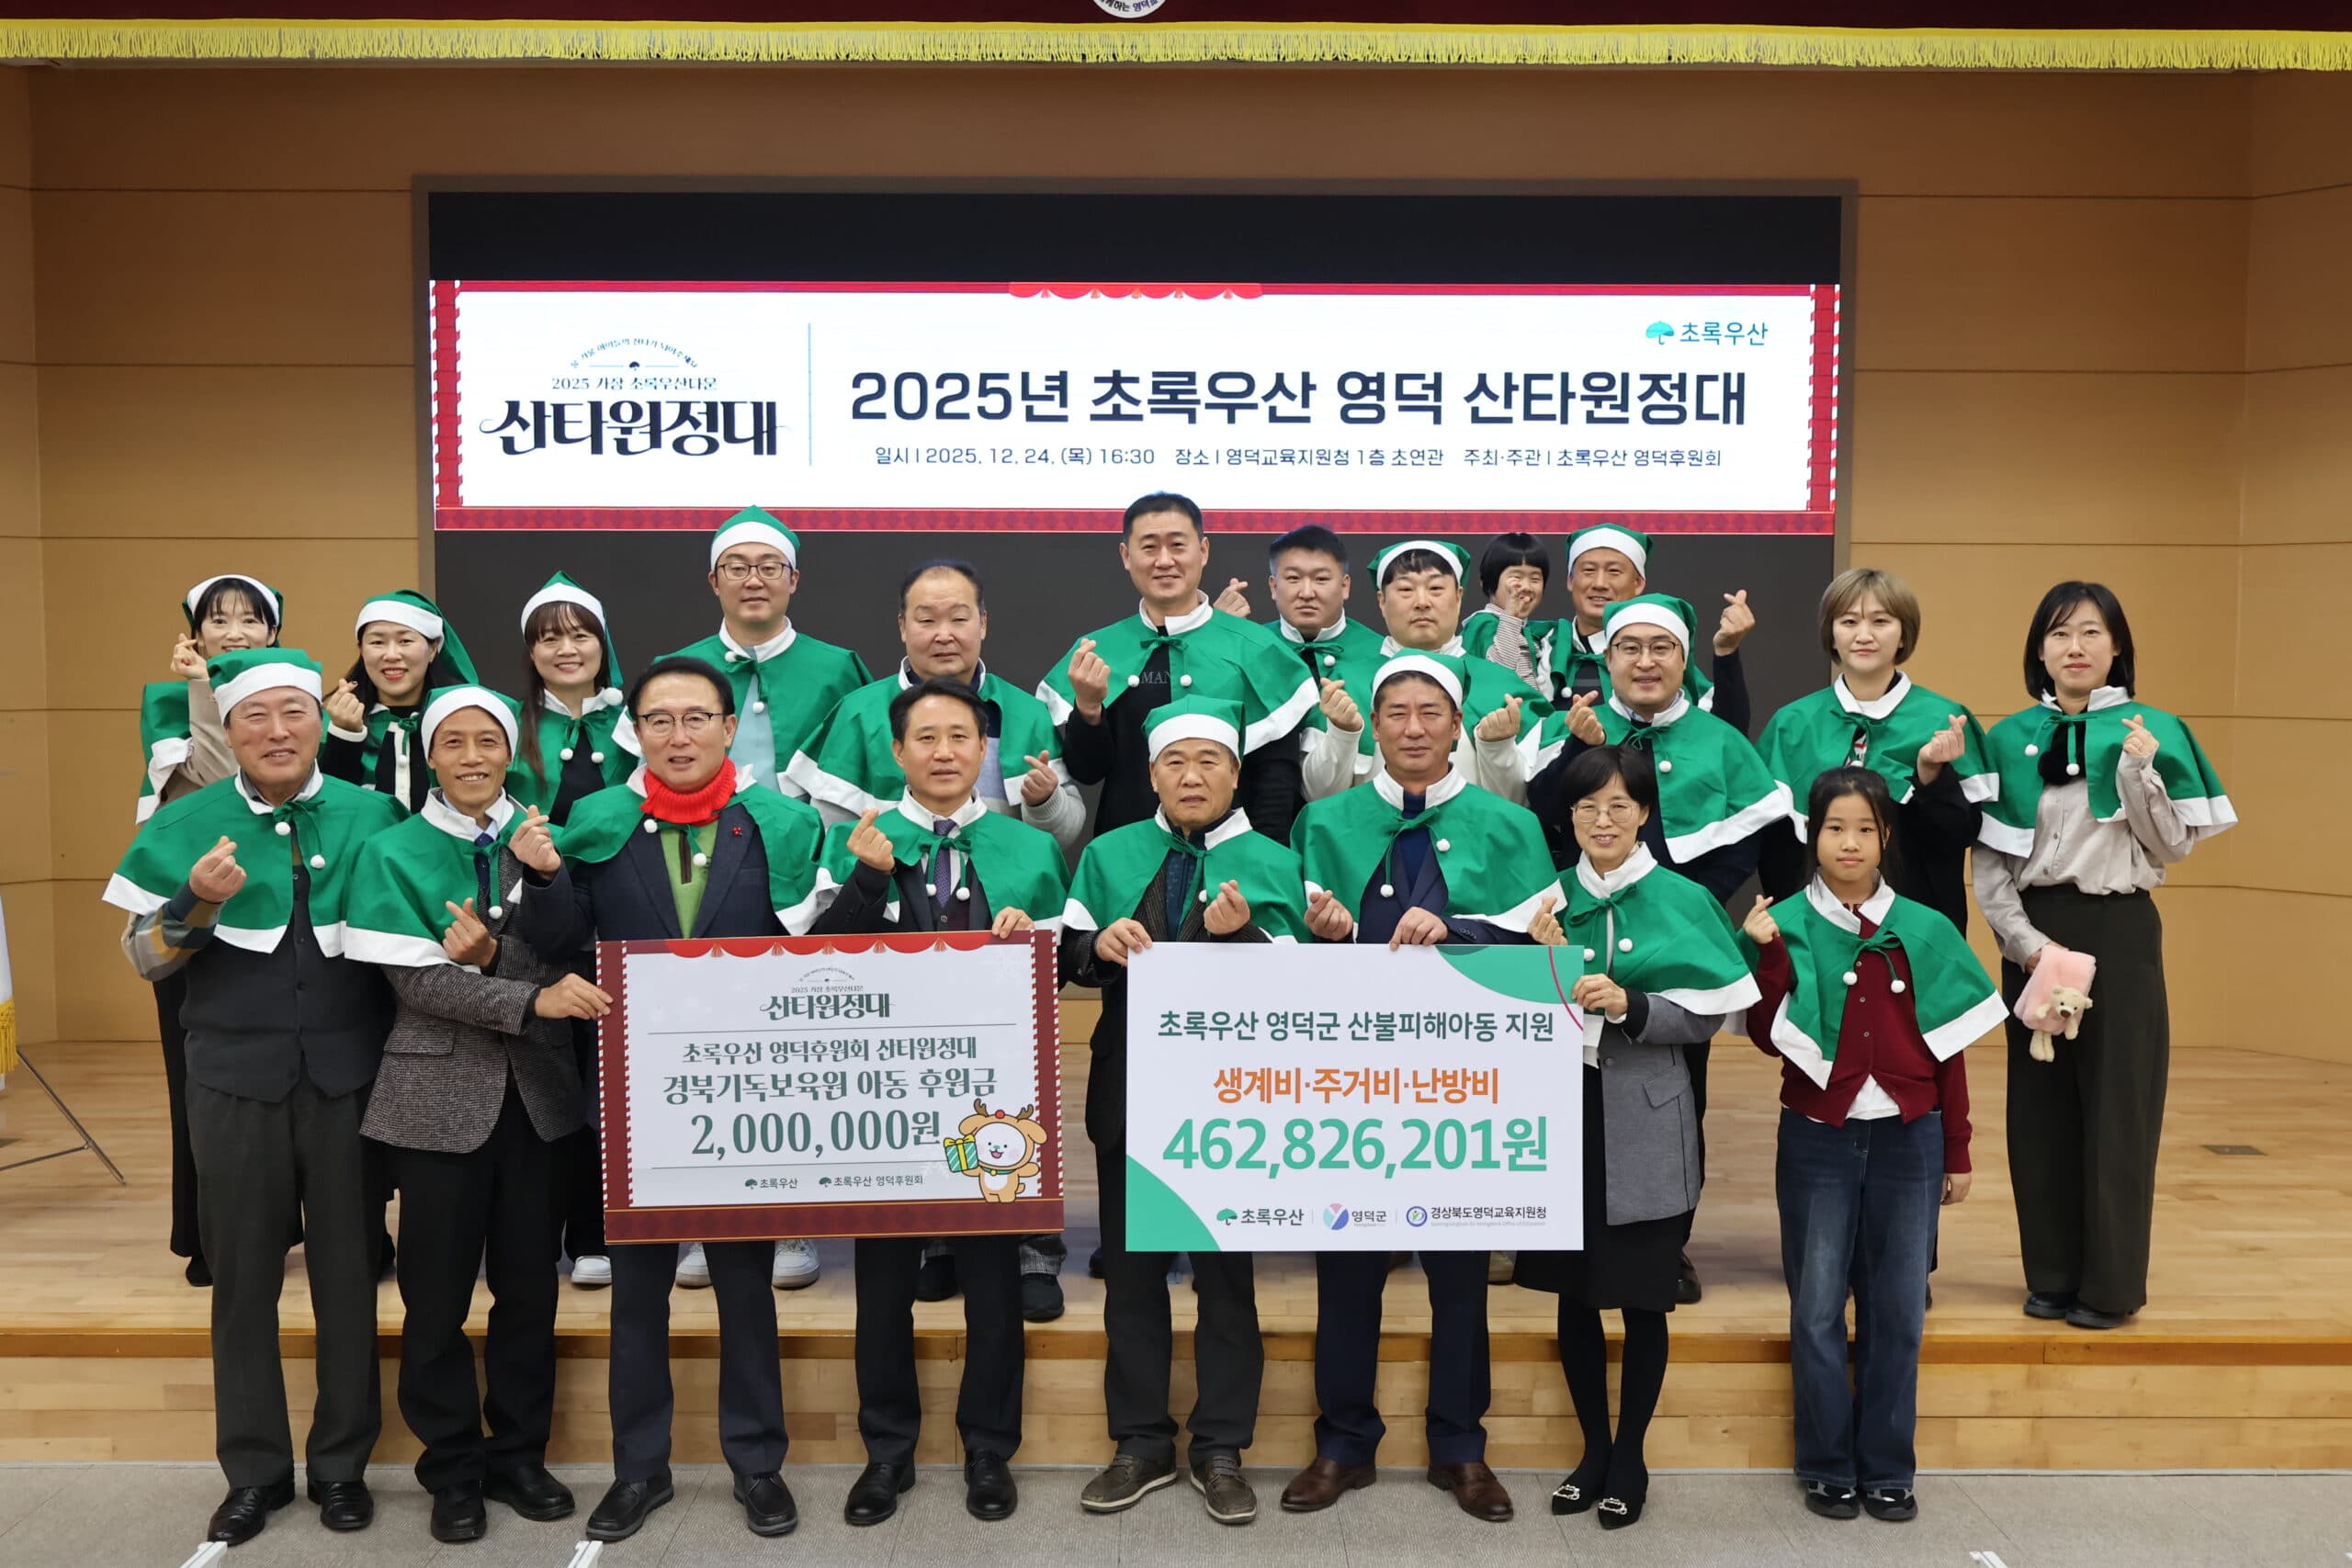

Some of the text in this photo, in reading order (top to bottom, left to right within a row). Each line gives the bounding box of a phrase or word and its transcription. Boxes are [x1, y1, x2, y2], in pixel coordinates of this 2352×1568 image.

[1679, 321, 1770, 346] 초록우산
[551, 378, 591, 390] 2025
[852, 368, 1746, 426] 2025년 초록우산 영덕 산타원정대
[479, 400, 786, 457] 산타원정대
[875, 446, 909, 466] 일시
[1060, 446, 1092, 466] (목)
[1100, 447, 1155, 465] 16:30
[1175, 447, 1444, 467] 장소 영덕교육지원청 1층 초연관
[1464, 448, 1721, 468] 주최·주관 초록우산 영덕후원회
[760, 993, 892, 1021] 산타원정대
[1158, 1010, 1555, 1043] 초록우산 영덕군 산불피해아동 지원
[683, 1036, 978, 1066] 초록우산 영덕후원회 산타원정대
[663, 1067, 998, 1105] 경북기독보육원 아동 후원금
[1213, 1066, 1498, 1105] 생계비·주거비·난방비
[691, 1110, 941, 1160] 2,000,000원
[1162, 1115, 1547, 1179] 462,826,201원
[760, 1178, 798, 1190] 초록우산
[833, 1175, 923, 1188] 초록우산 영덕후원회
[1241, 1207, 1305, 1226] 초록우산
[1351, 1210, 1387, 1223] 영덕군
[1430, 1205, 1547, 1220] 경상북도영덕교육지원청
